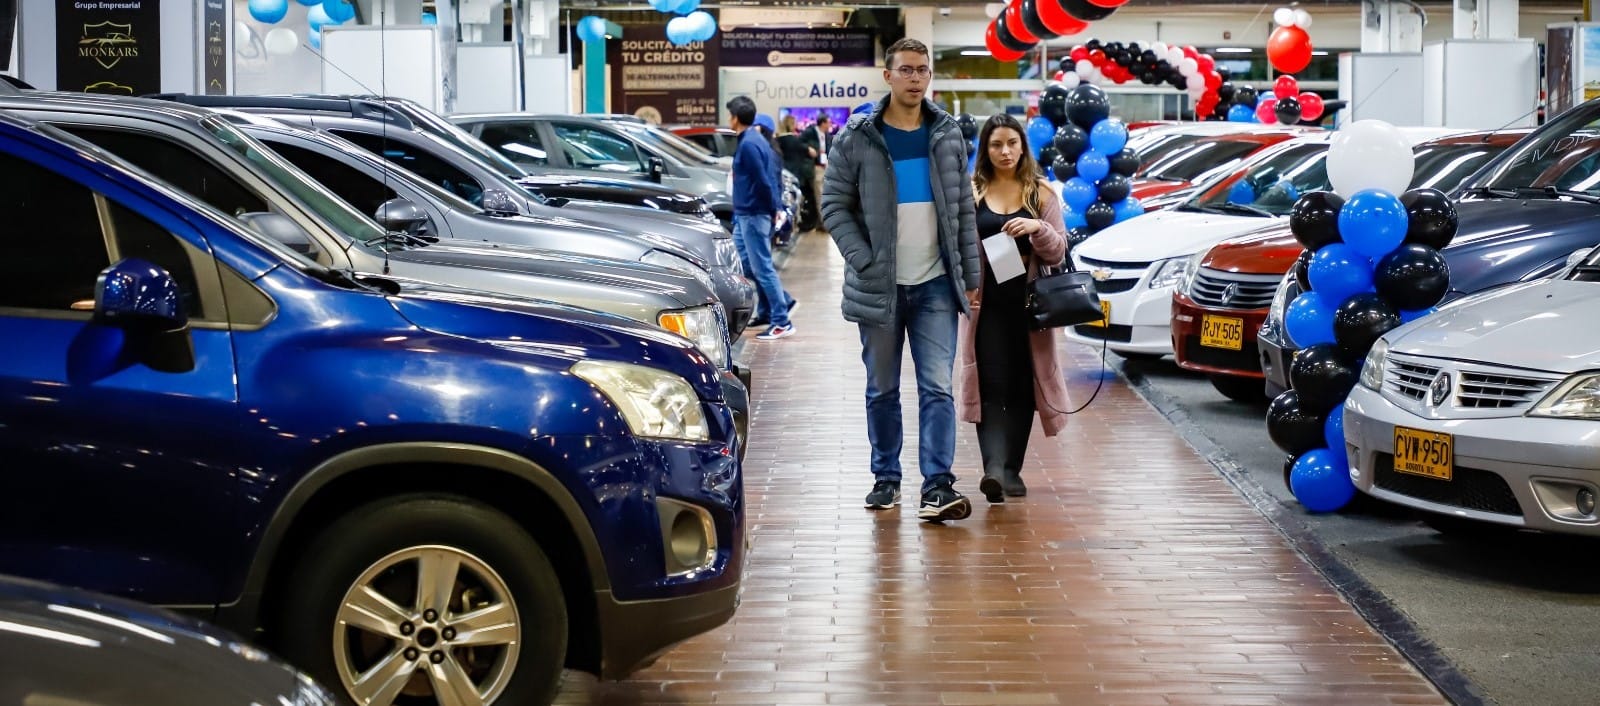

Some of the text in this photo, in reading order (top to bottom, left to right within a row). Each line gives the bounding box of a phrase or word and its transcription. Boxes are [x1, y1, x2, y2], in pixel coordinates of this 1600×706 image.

[74, 2, 141, 11] Grupo Empresarial
[622, 41, 673, 50] SOLICITA
[722, 40, 736, 48] DE
[793, 40, 829, 48] NUEVO
[78, 47, 138, 57] MONKARS
[622, 50, 705, 63] TU CRÉDITO
[676, 104, 716, 115] elijas la
